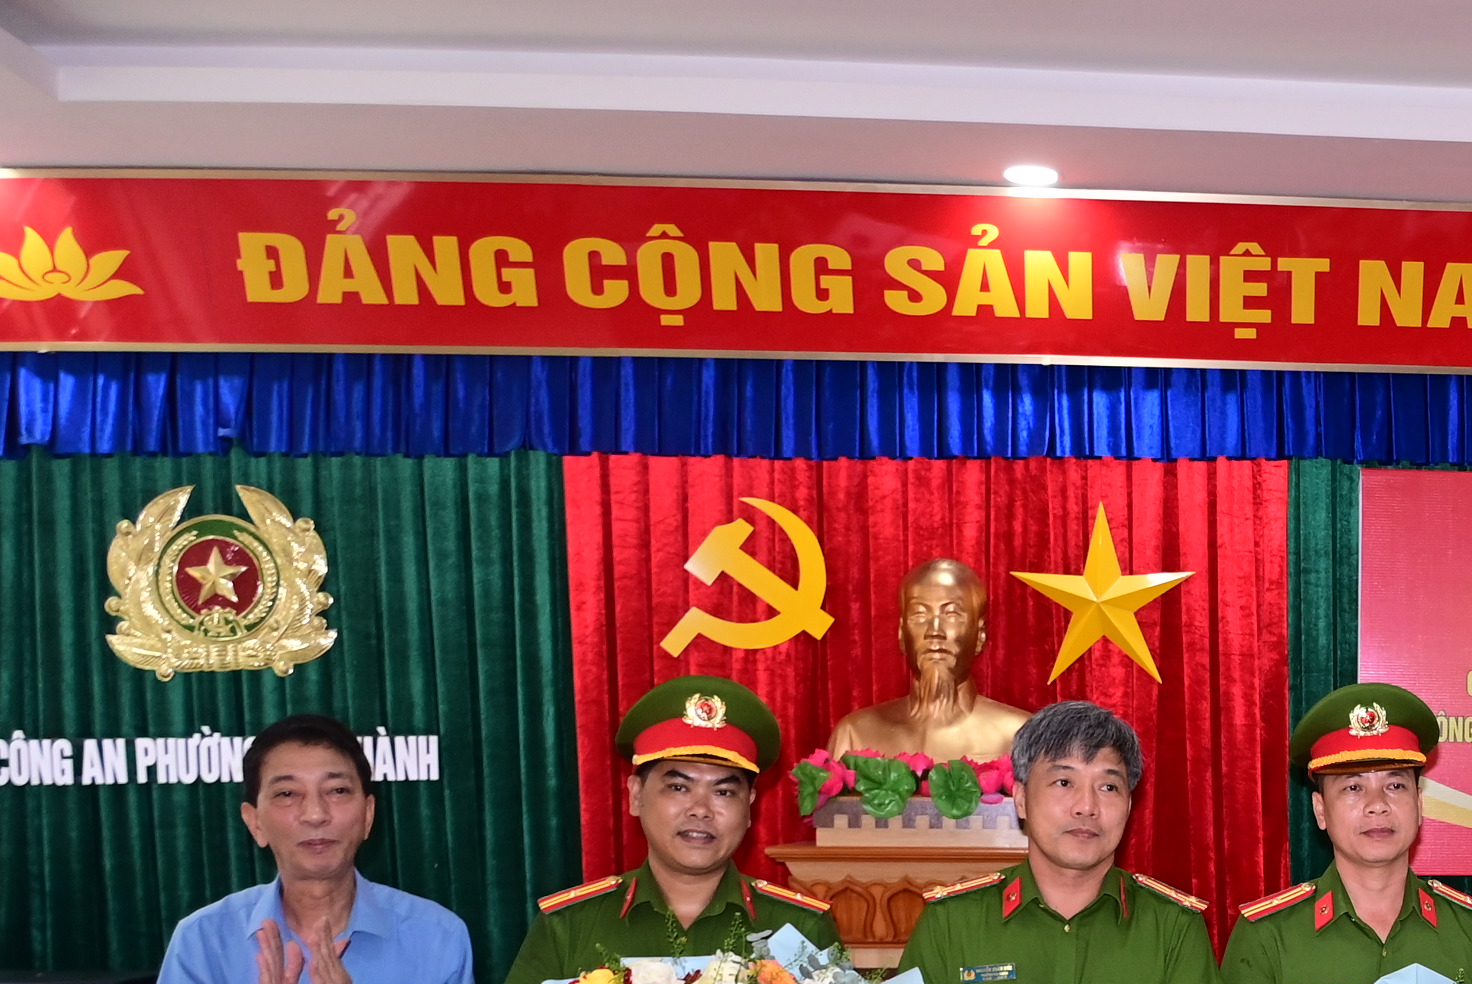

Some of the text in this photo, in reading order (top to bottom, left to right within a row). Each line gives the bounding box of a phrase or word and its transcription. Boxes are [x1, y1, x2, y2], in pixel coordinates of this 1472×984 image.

[236, 207, 540, 308] ĐẢNG
[562, 223, 855, 327] CỘNG
[883, 223, 1095, 320] SẢN
[1119, 242, 1331, 340] VIỆT
[82, 738, 129, 786] AN
[134, 725, 256, 785] PHƯỜN
